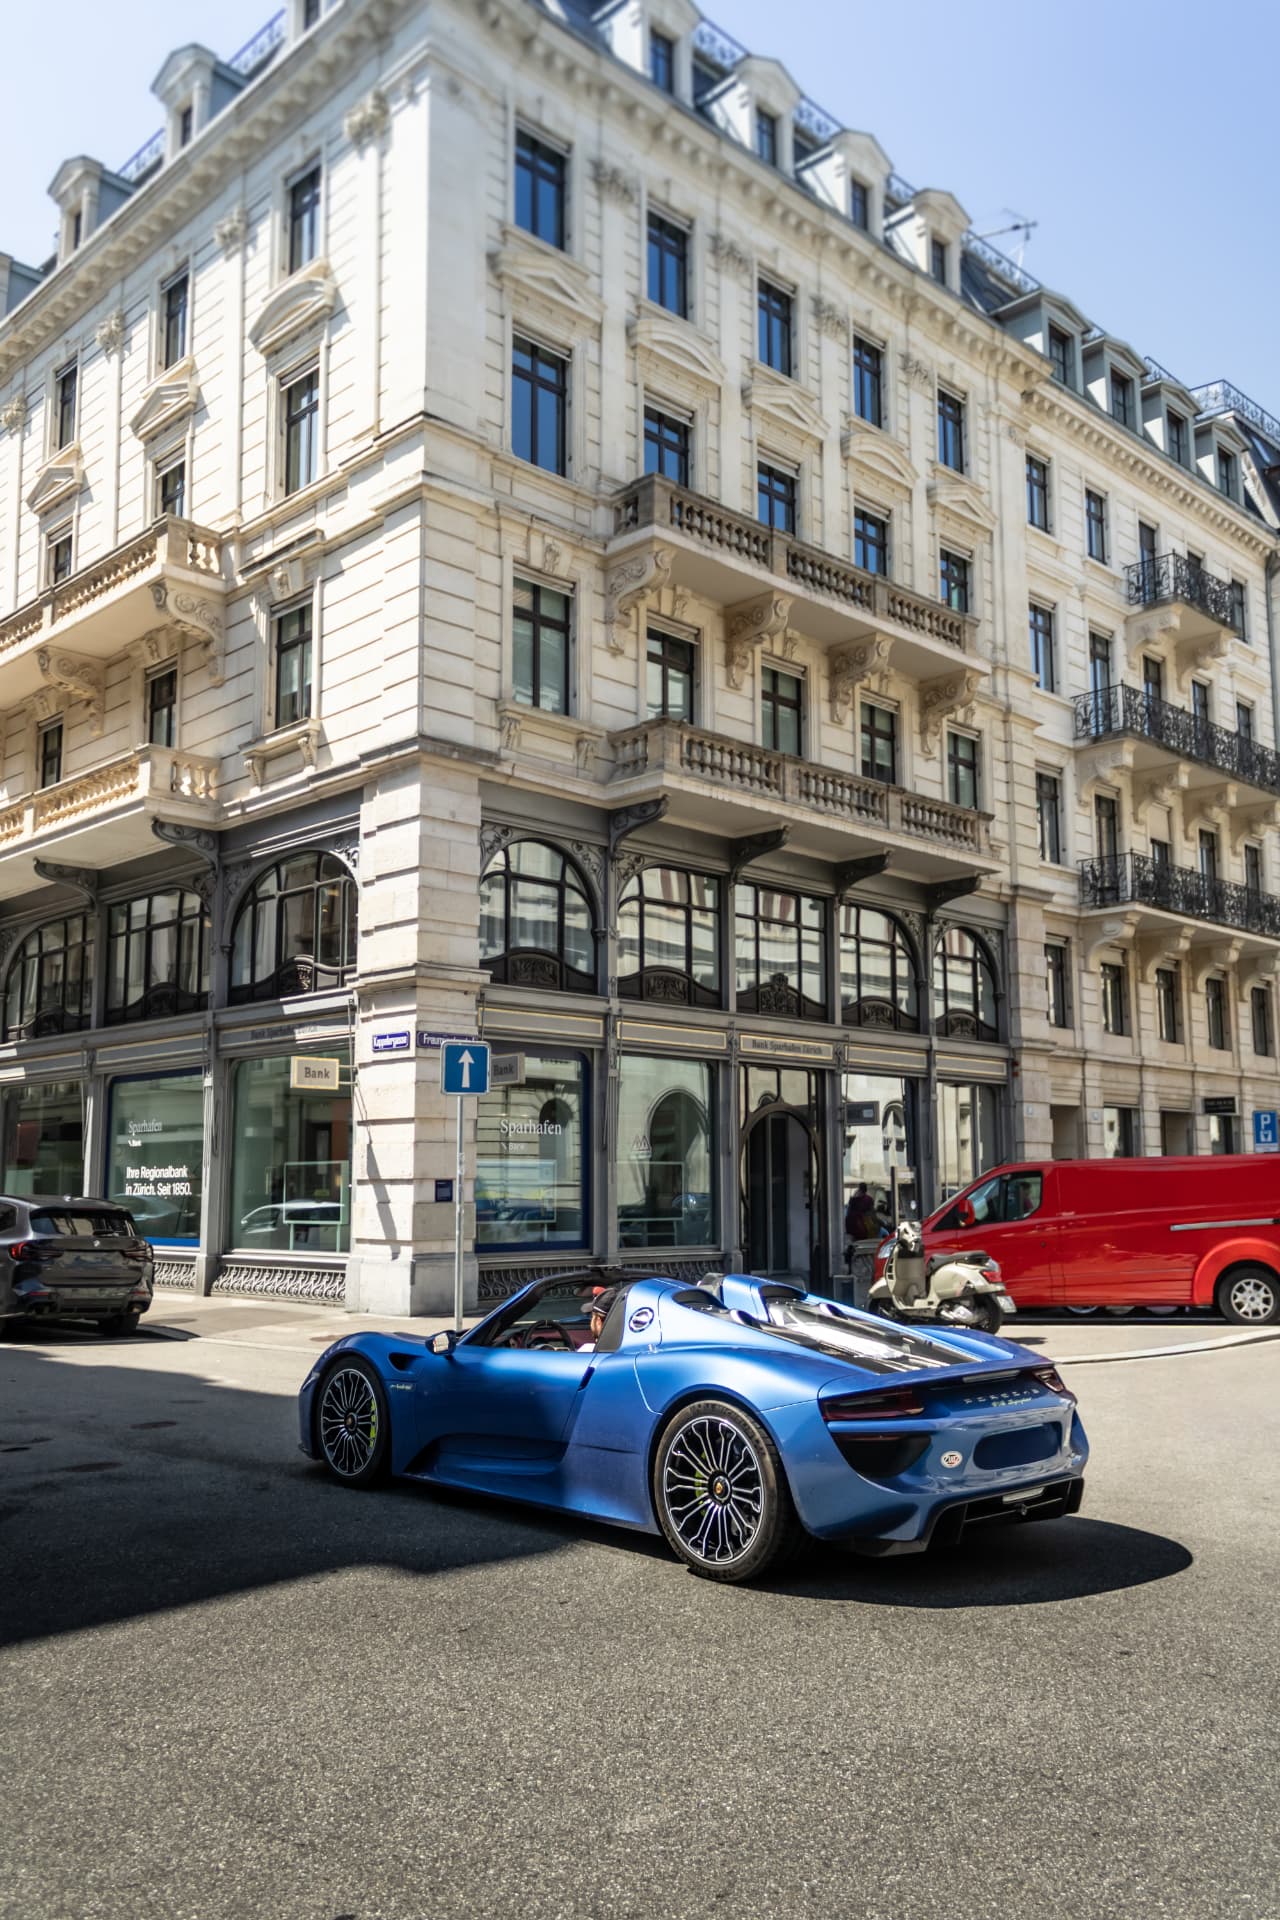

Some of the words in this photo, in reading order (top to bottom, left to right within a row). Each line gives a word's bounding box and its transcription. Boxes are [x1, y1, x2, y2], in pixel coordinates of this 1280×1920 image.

[304, 1067, 330, 1079] Bank
[493, 1063, 514, 1076] Bank
[128, 1119, 162, 1136] Sparhafen
[500, 1119, 562, 1136] Sparhafen
[1260, 1113, 1271, 1130] P
[126, 1166, 140, 1179] Ihre
[141, 1164, 188, 1181] Regionalbank
[125, 1183, 132, 1196] in
[133, 1183, 156, 1196] Zürich.
[157, 1182, 171, 1195] Seit
[172, 1182, 192, 1196] 1850.
